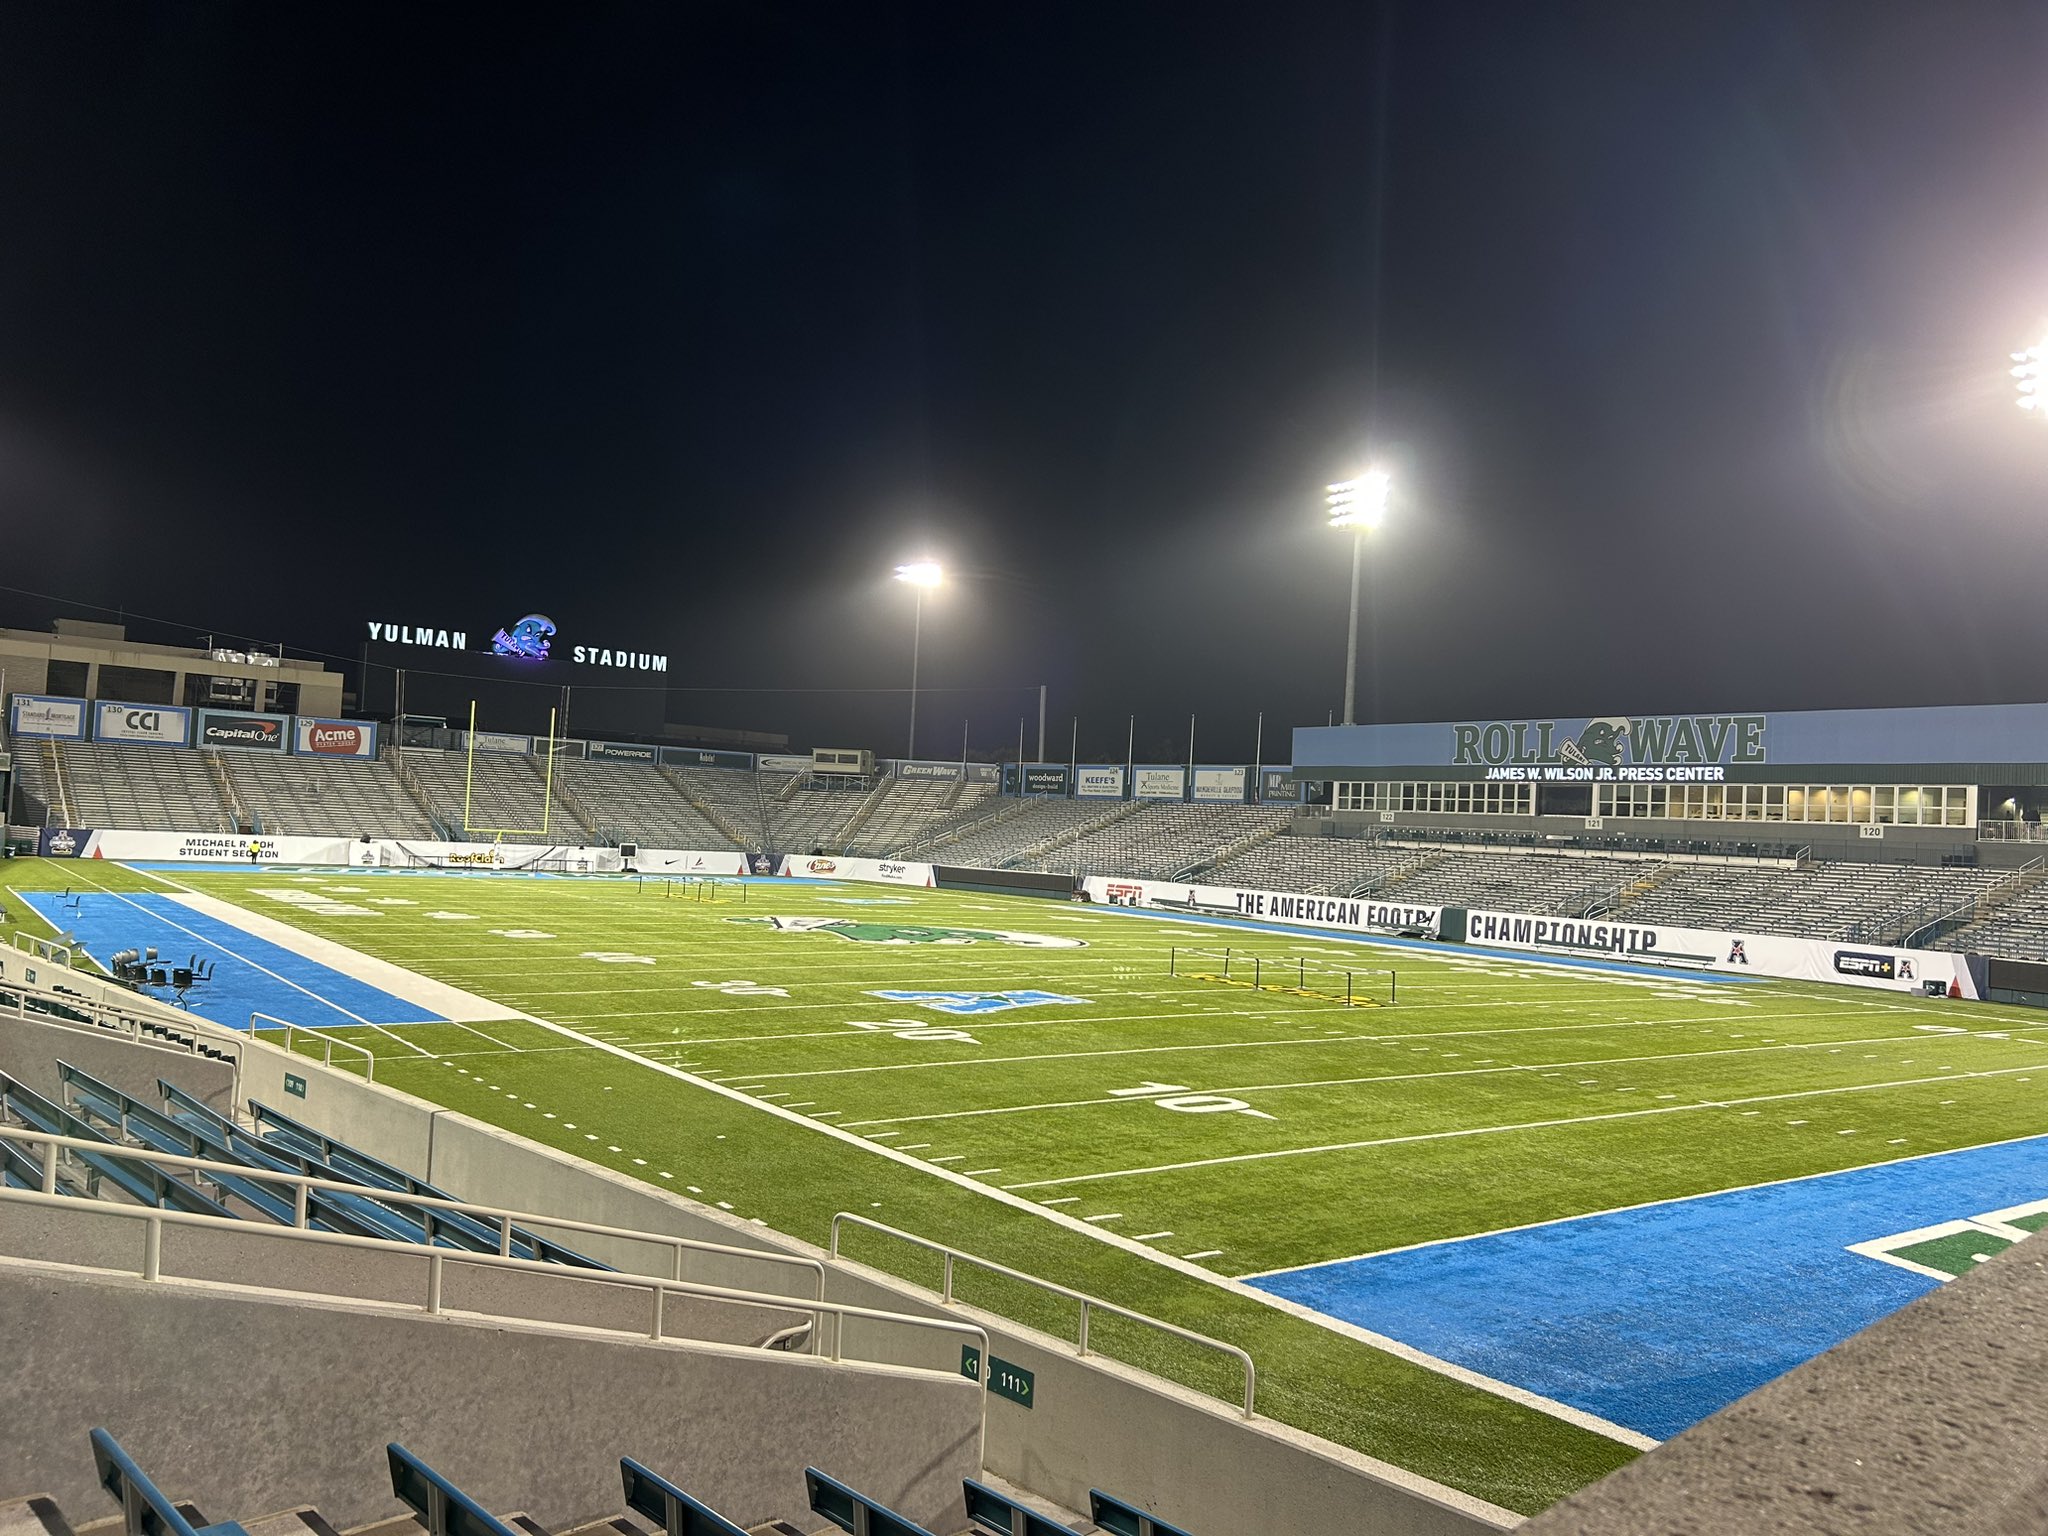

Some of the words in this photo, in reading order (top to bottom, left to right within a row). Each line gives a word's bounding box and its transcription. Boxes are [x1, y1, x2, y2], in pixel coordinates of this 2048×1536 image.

[367, 621, 467, 651] YULMAN
[573, 646, 668, 672] STADIUM
[16, 698, 30, 706] 131
[22, 710, 46, 719] STANDARD
[125, 711, 160, 731] CCI
[315, 728, 356, 742] Acme
[1452, 722, 1563, 765] ROLL
[1628, 715, 1766, 764] WAVE
[604, 748, 652, 758] POWERADE
[1028, 773, 1063, 782] woodward
[1146, 772, 1170, 781] Tulane
[1485, 767, 1525, 780] JAMES
[1527, 767, 1542, 780] W.
[1545, 767, 1594, 780] WILSON
[1596, 767, 1617, 780] JR.
[1619, 767, 1663, 781] PRESS
[1666, 766, 1724, 781] CENTER
[1085, 776, 1115, 785] KEEFE'S
[1268, 790, 1296, 798] PRINTING
[1382, 813, 1393, 821] 122
[1588, 820, 1600, 828] 121
[1863, 827, 1880, 837] 120
[185, 838, 236, 848] MICHAEL
[239, 840, 249, 848] R.
[179, 848, 229, 857] STUDENT
[232, 849, 279, 858] SECION
[878, 862, 906, 874] stryker
[1106, 883, 1143, 899] ESPN
[1236, 892, 1264, 915] THE
[1270, 896, 1361, 925] AMERICAN
[1470, 914, 1657, 951] CHAMPIONSHIP
[1106, 1081, 1254, 1113] 10
[1001, 1372, 1020, 1393] 111
